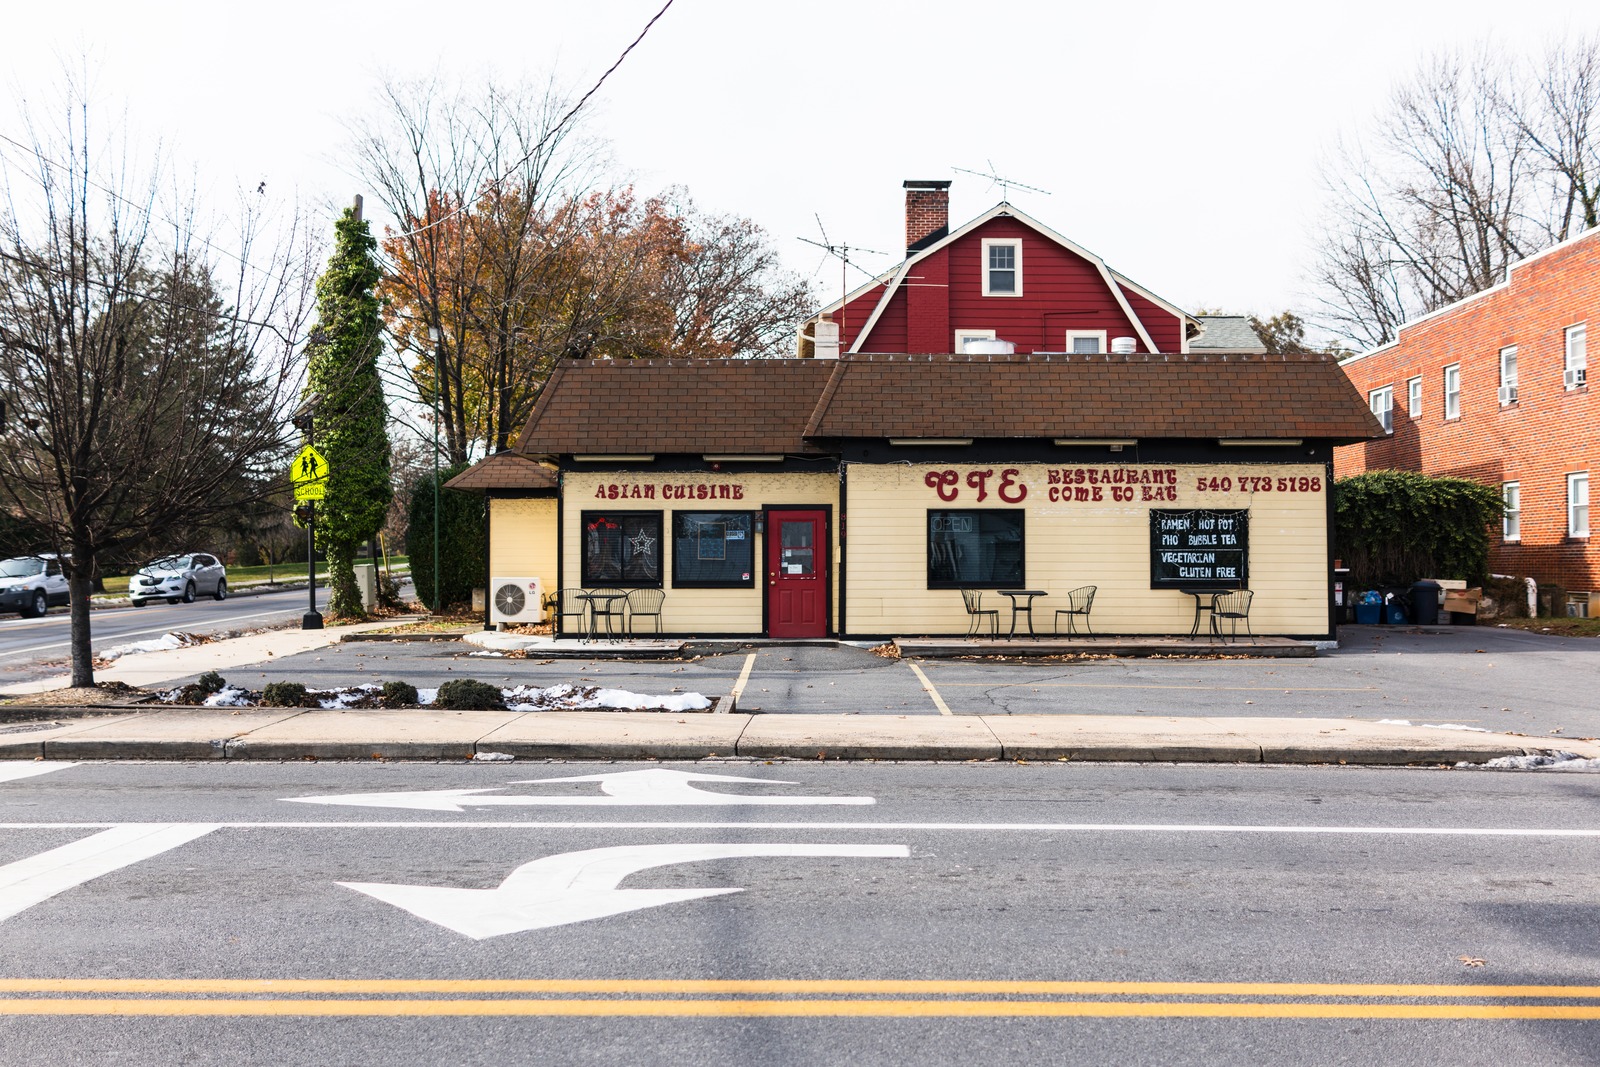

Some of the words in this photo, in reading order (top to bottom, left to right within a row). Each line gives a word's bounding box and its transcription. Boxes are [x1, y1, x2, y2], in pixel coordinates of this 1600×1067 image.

[1047, 469, 1177, 485] RESTAURANT
[925, 469, 1027, 503] CTE
[1196, 476, 1232, 492] 540
[1237, 476, 1273, 492] 773
[1276, 476, 1322, 492] 5198
[296, 487, 323, 496] SCHOOL
[594, 484, 655, 499] ASIAN
[662, 484, 744, 500] CUISINE
[1049, 486, 1103, 502] COME
[1111, 486, 1134, 502] TO
[1141, 485, 1177, 501] EAT
[933, 518, 970, 531] OPEN
[1161, 519, 1190, 530] RAMEN
[1198, 519, 1215, 530] HOT
[1218, 519, 1234, 530] POT
[1162, 534, 1179, 545] PHO
[1188, 534, 1217, 545] BUBBLE
[1221, 534, 1236, 545] TEA
[1161, 552, 1215, 563] VEGETARIAN
[1180, 567, 1211, 578] GLUTEN
[1216, 567, 1236, 578] FREE
